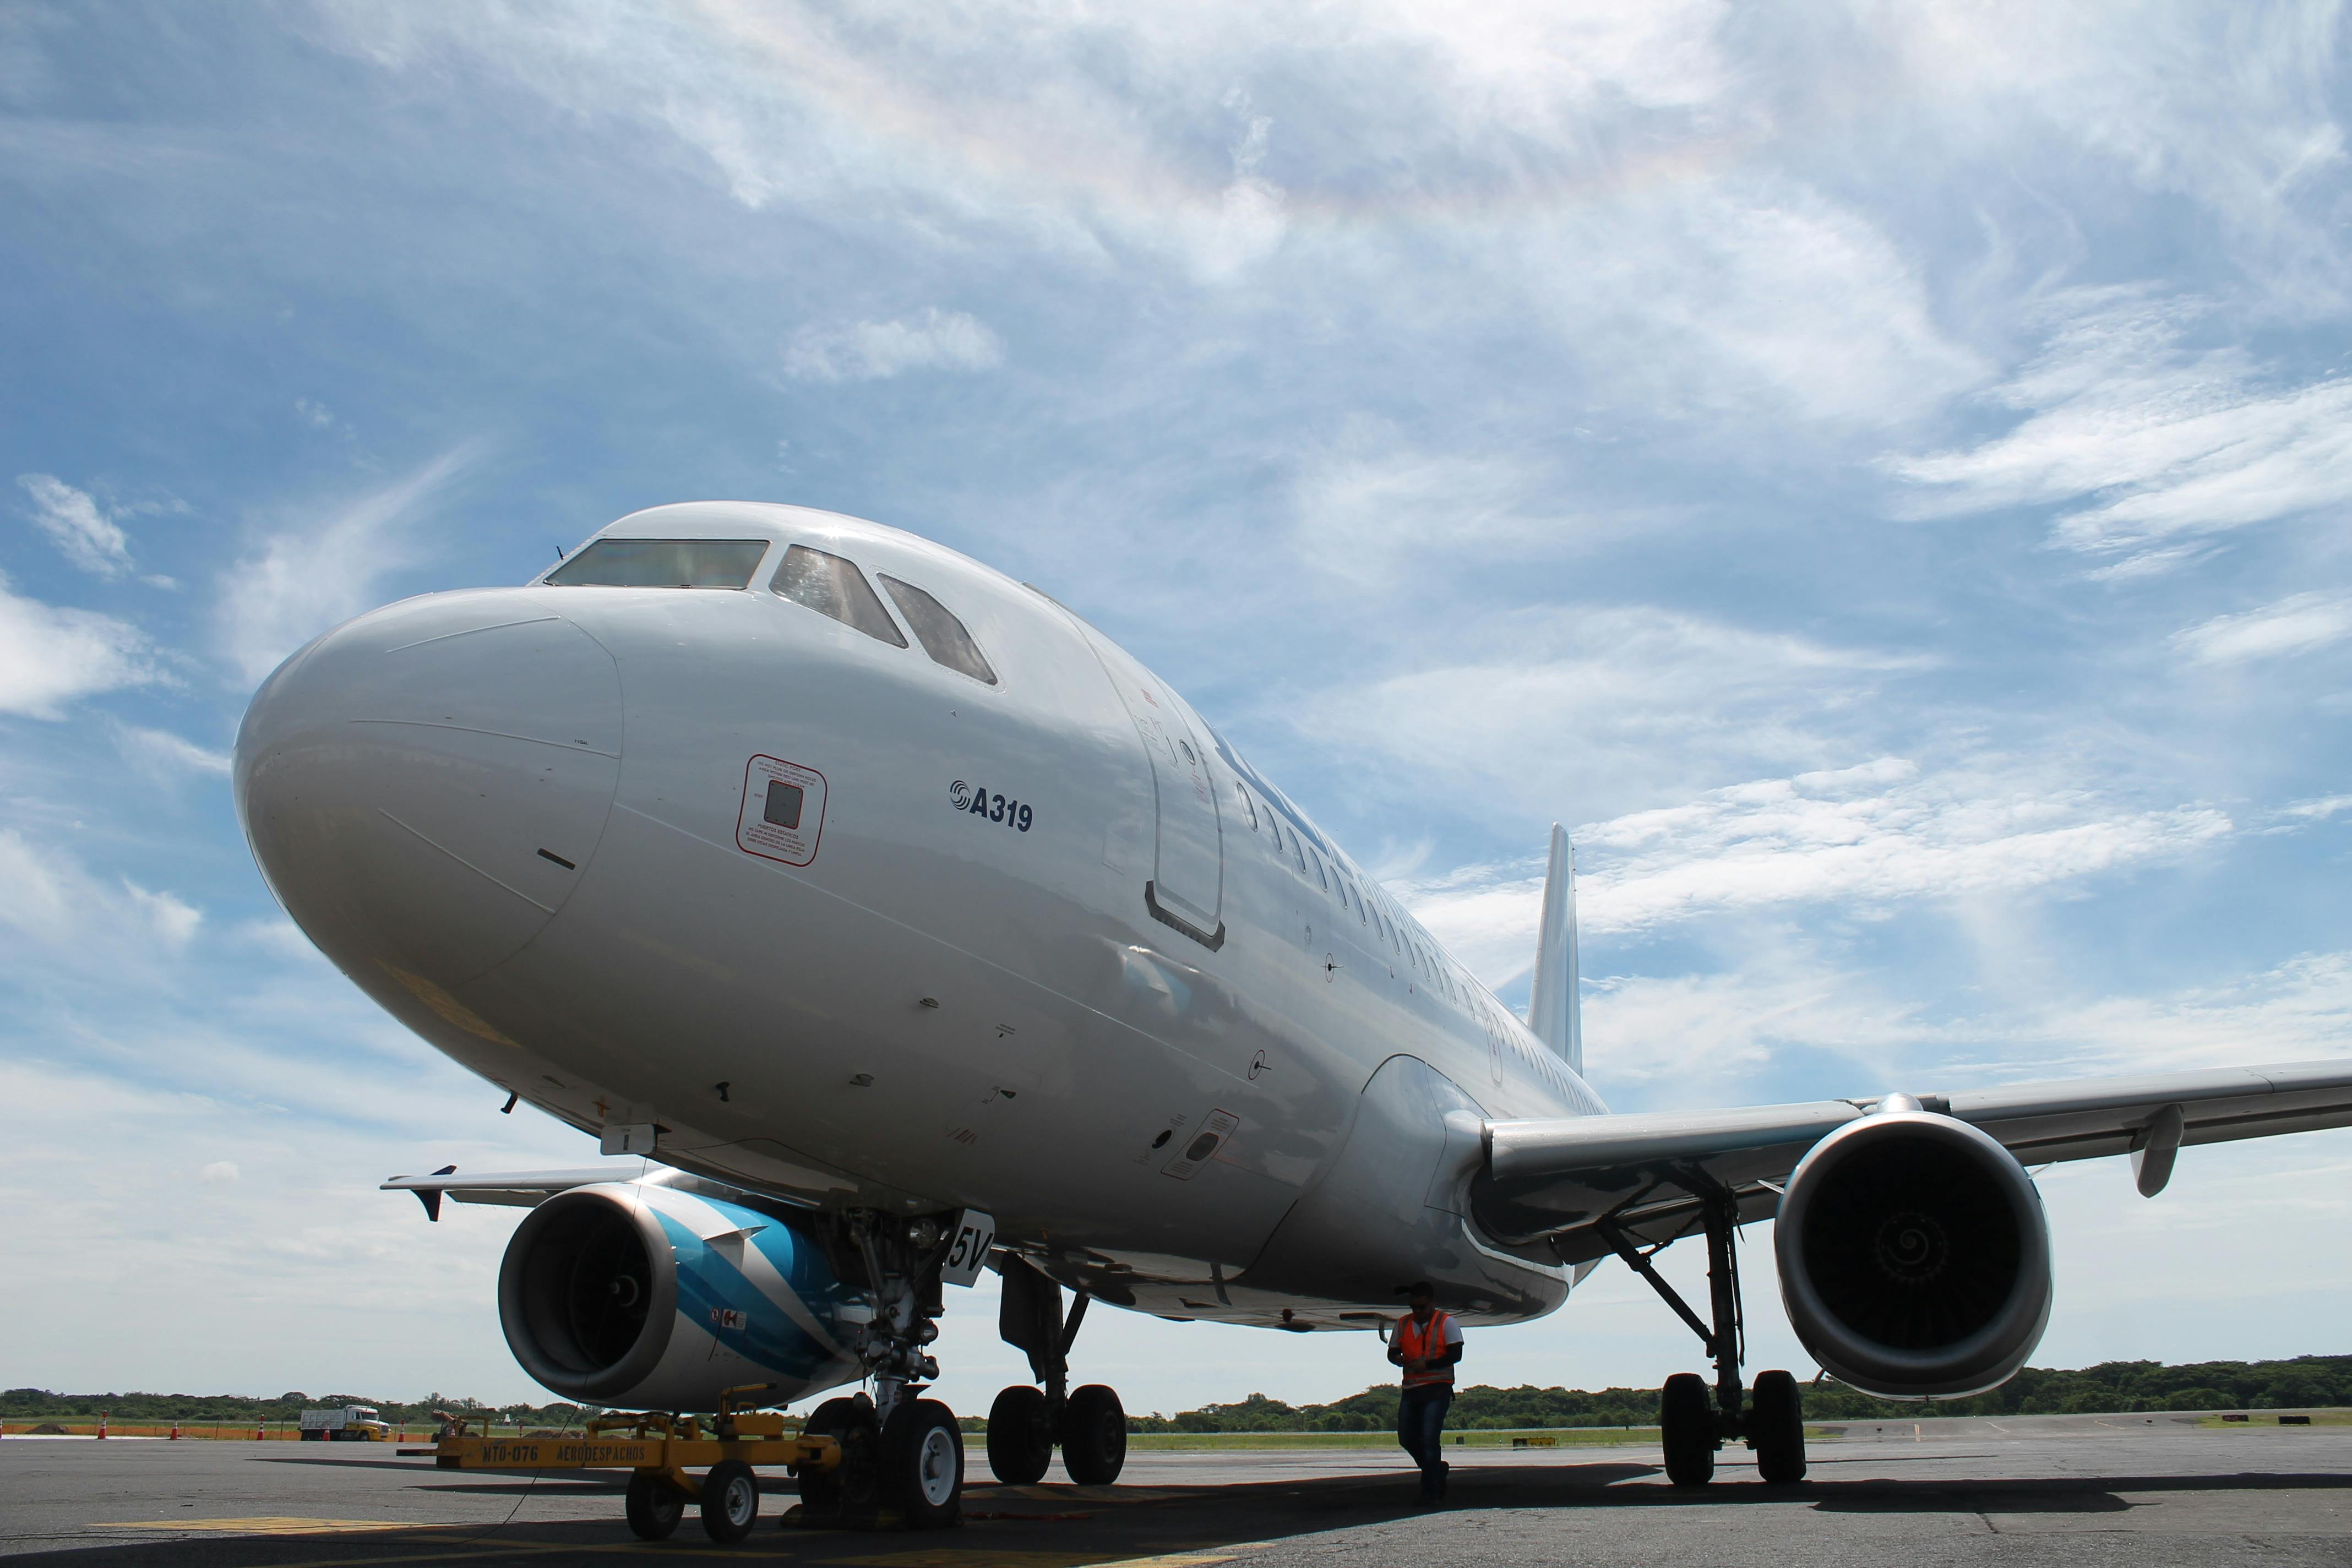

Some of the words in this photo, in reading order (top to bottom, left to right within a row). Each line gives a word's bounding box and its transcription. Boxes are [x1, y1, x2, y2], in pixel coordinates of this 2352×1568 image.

[775, 760, 788, 769] STATIC
[969, 787, 1033, 832] A319
[758, 824, 776, 832] PUERTOS
[777, 829, 798, 839] ESTATICOS
[949, 1226, 994, 1271] 5V
[482, 1445, 538, 1463] MTO-076
[556, 1445, 645, 1462] AERODESPACHOS
